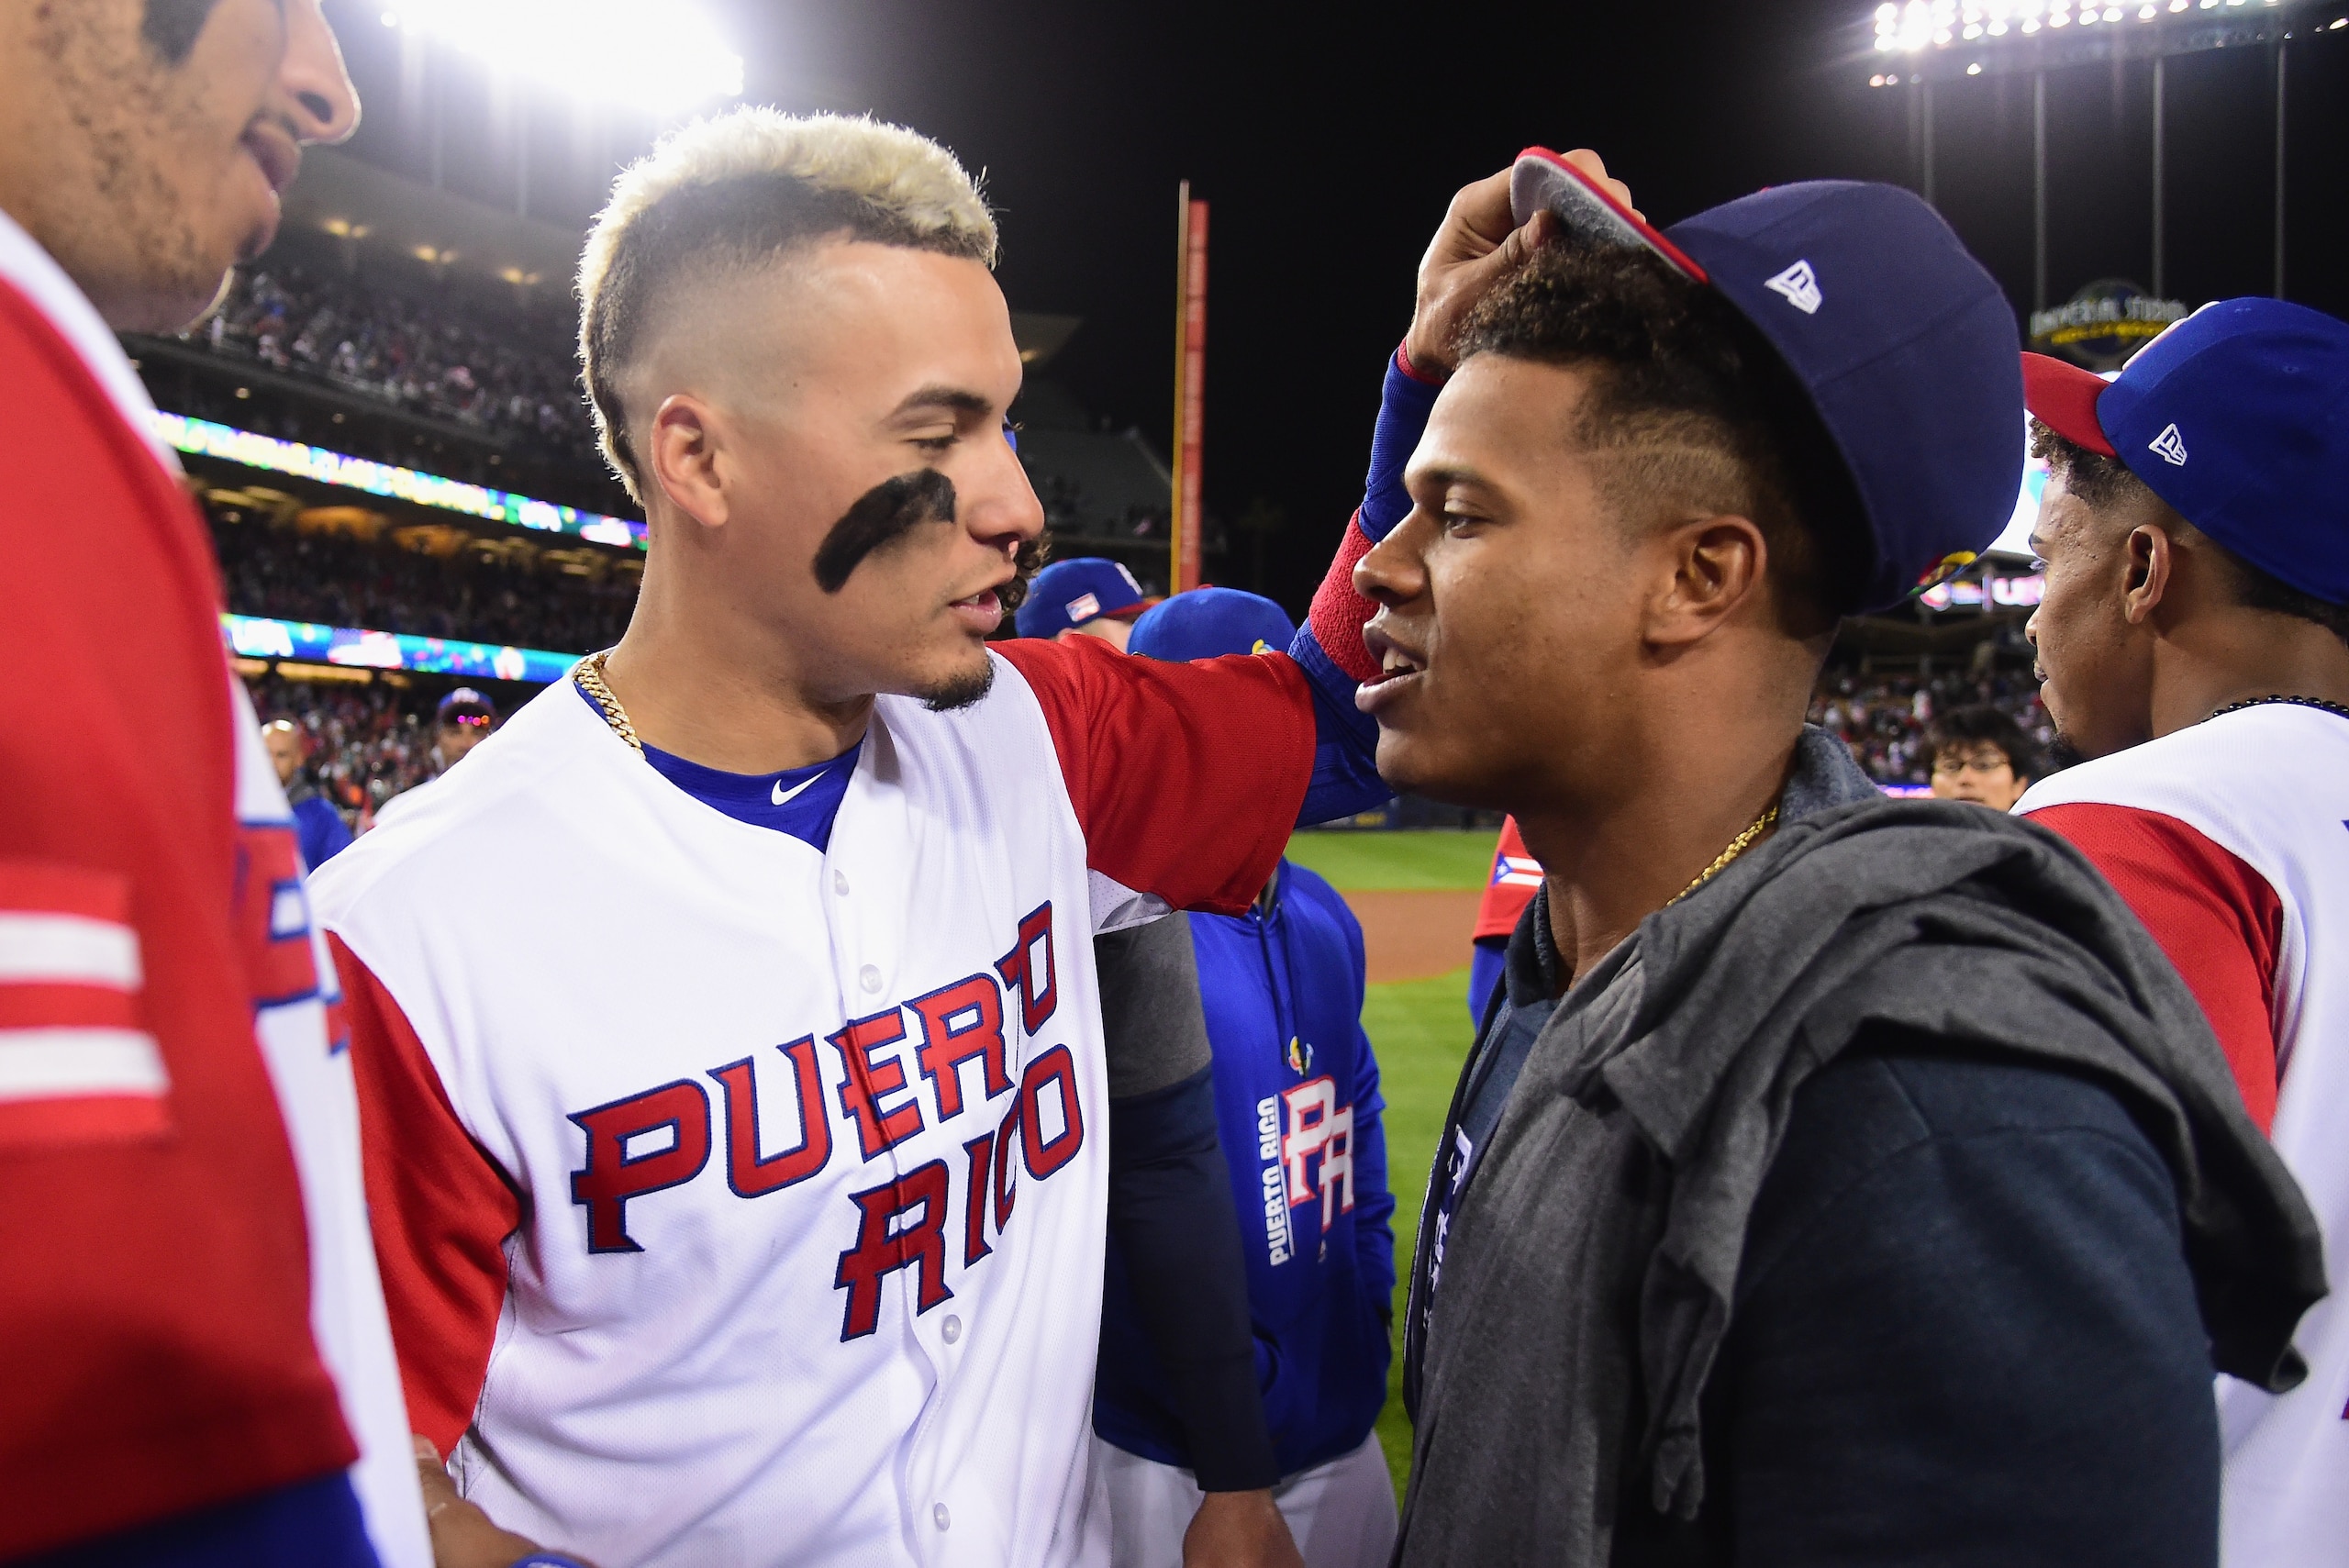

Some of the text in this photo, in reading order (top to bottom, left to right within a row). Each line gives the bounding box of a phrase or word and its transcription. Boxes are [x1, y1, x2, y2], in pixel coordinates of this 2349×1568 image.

[566, 900, 1059, 1255] PUERO
[1281, 1074, 1355, 1234] PR
[1257, 1095, 1290, 1267] PUERTO RICO
